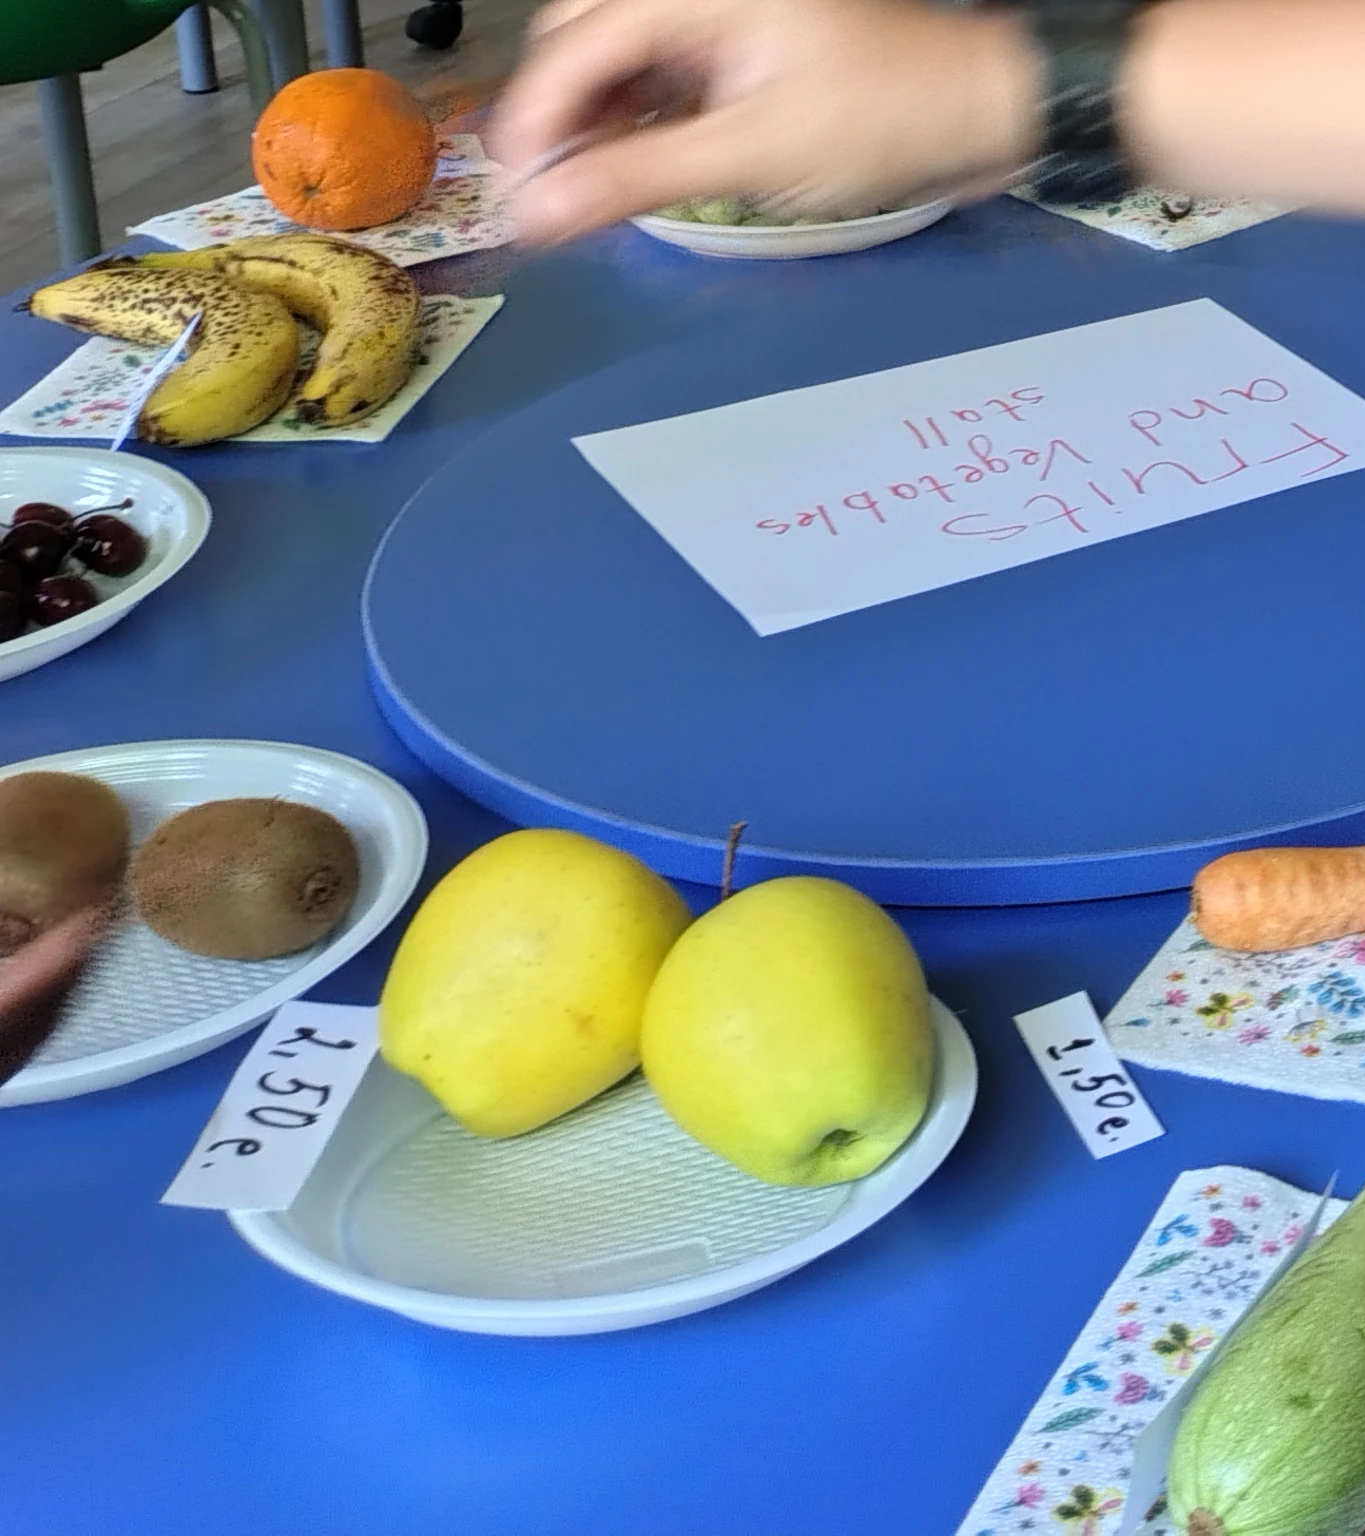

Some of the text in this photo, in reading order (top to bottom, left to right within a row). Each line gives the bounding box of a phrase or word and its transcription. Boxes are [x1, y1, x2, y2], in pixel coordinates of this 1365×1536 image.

[901, 384, 1047, 451] stall
[1128, 376, 1290, 447] and
[938, 420, 1353, 542] Fruits
